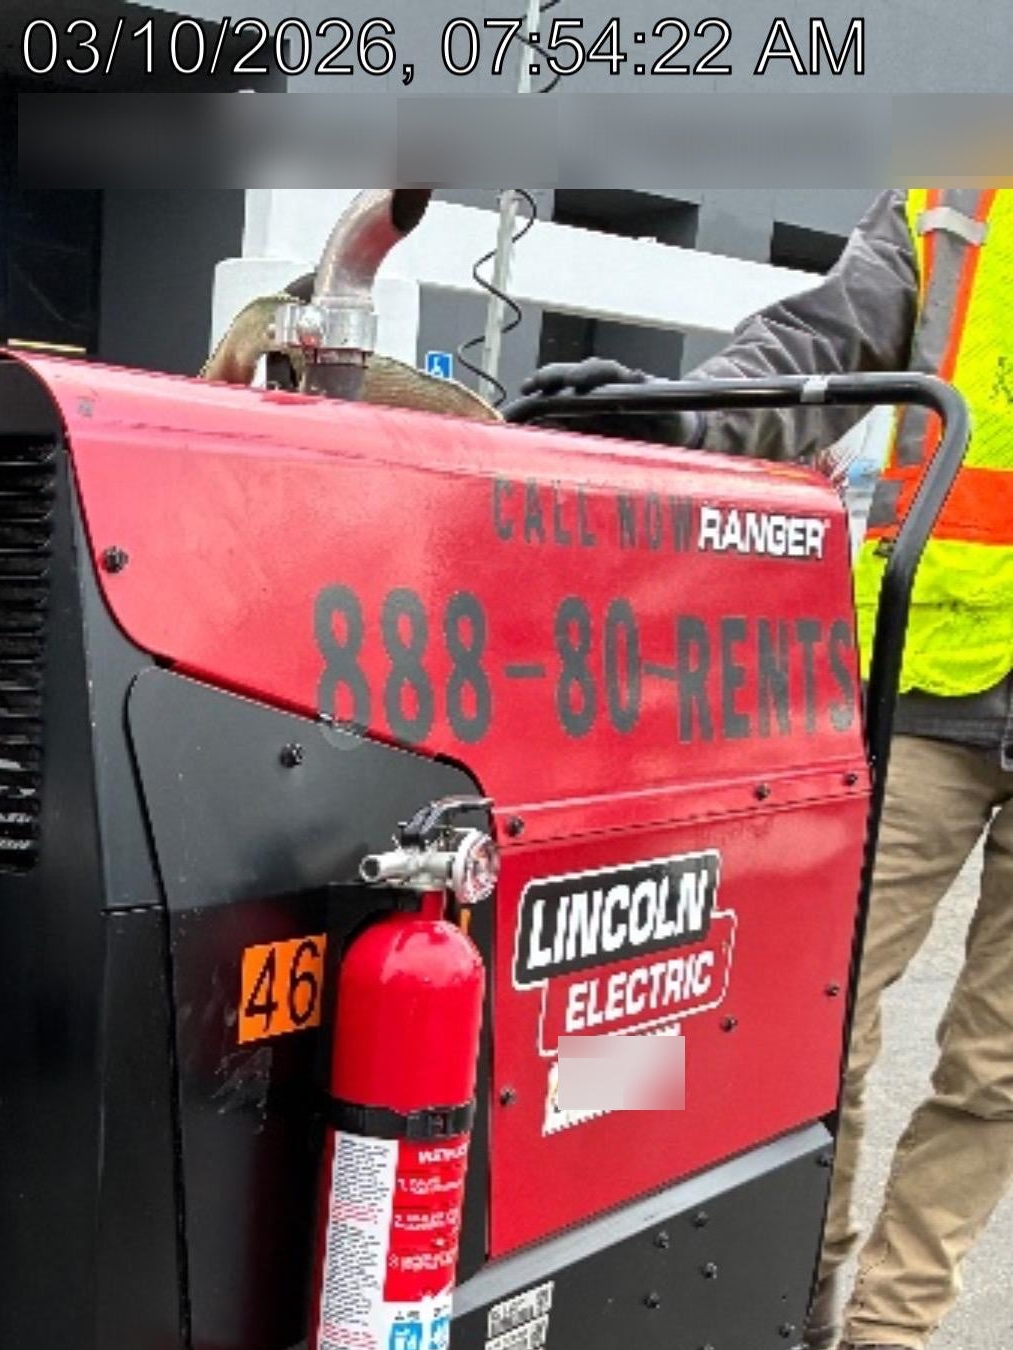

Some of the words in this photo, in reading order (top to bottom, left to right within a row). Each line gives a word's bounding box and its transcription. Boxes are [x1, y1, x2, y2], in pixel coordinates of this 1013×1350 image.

[492, 475, 597, 546] CALL
[615, 488, 696, 552] NOW
[698, 504, 827, 559] RANGER
[313, 583, 855, 750] 888-80-RENTS
[526, 869, 709, 970] LINCOLN
[244, 940, 321, 1032] 46
[565, 950, 715, 1033] ELECTRIC
